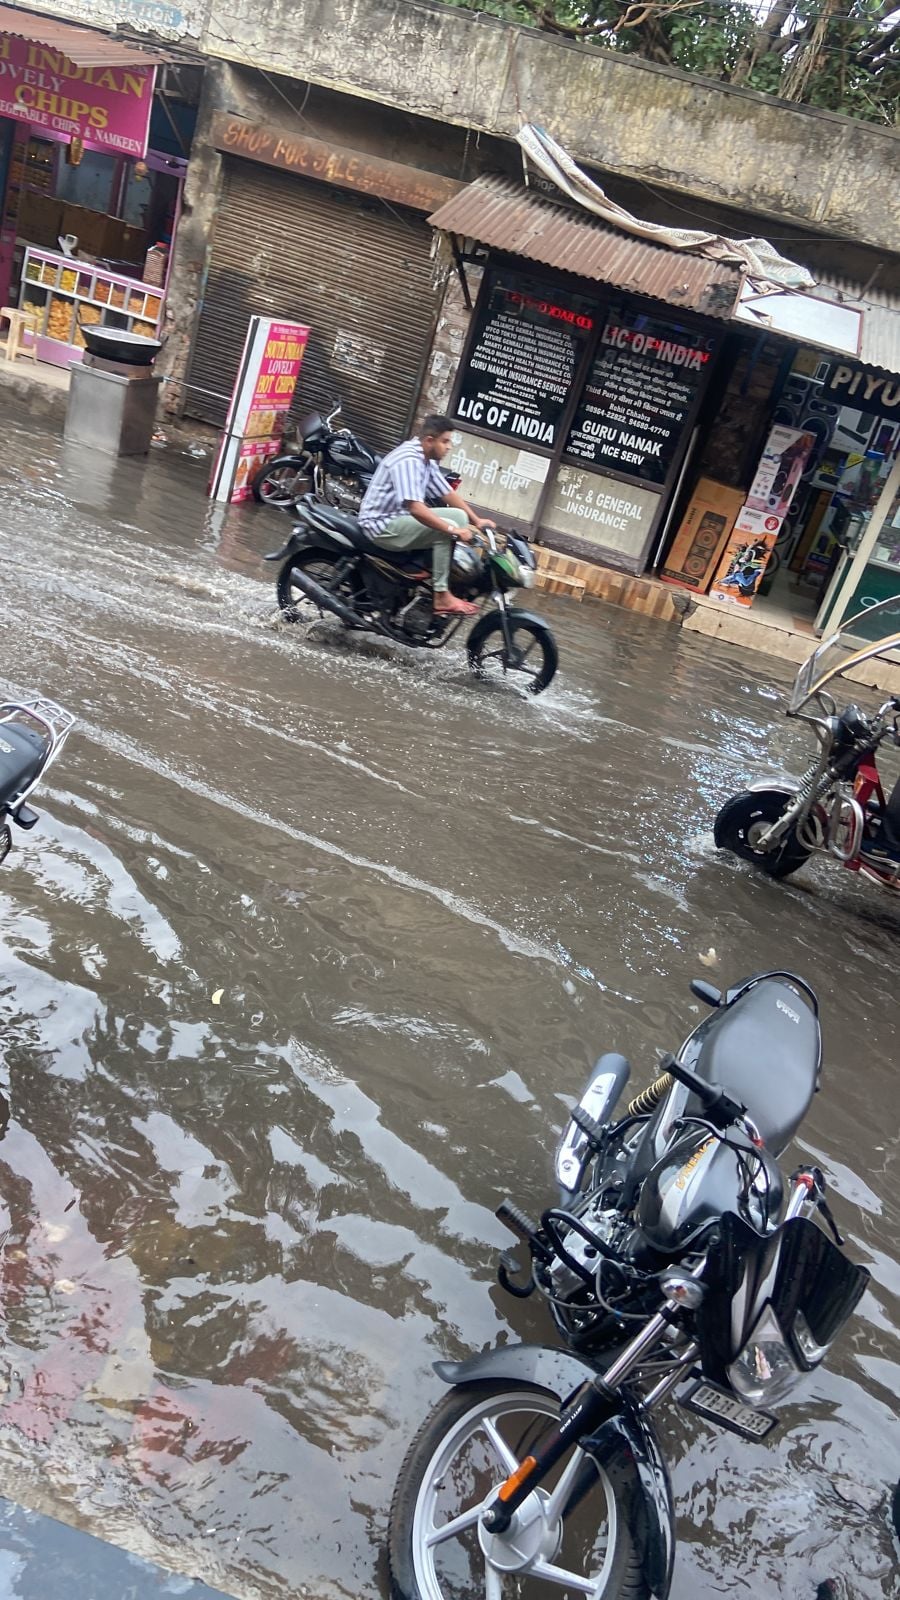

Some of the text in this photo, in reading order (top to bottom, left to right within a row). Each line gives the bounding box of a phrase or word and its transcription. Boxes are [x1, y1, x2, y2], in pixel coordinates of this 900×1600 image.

[28, 45, 146, 98] INDIAN
[15, 85, 109, 128] CHIPS
[52, 116, 80, 135] CHIPS
[84, 128, 91, 138] &
[94, 130, 143, 151] NAMKEEN
[224, 121, 270, 151] SHOP
[273, 139, 307, 167] FOR
[313, 153, 358, 182] SALE
[483, 332, 502, 342] FUTURE
[538, 349, 566, 362] INSURANCE
[501, 330, 517, 339] TOKYO
[537, 341, 566, 353] INSURANCE
[535, 332, 563, 345] INSURANCE
[601, 324, 703, 371] LIC OF INDIA
[268, 360, 295, 374] LOVELY
[533, 356, 561, 368] INSURANCE
[535, 362, 563, 376] INSURANCE
[256, 376, 275, 393] HOT
[470, 358, 568, 395] GURU NANAK INSURANCE SERVICE
[534, 370, 562, 382] INSURANCE
[586, 385, 601, 394] Third
[602, 390, 618, 400] Party
[458, 398, 484, 420] LIC
[487, 407, 510, 427] OF
[511, 414, 554, 444] INDIA
[609, 402, 651, 422] Rohit Chhabra
[582, 420, 663, 456] GURU NANAK
[601, 444, 645, 465] NCE SERV
[481, 459, 499, 484] ही
[566, 501, 628, 531] INSURANCE
[585, 490, 593, 503] &
[596, 493, 642, 520] GENERAL
